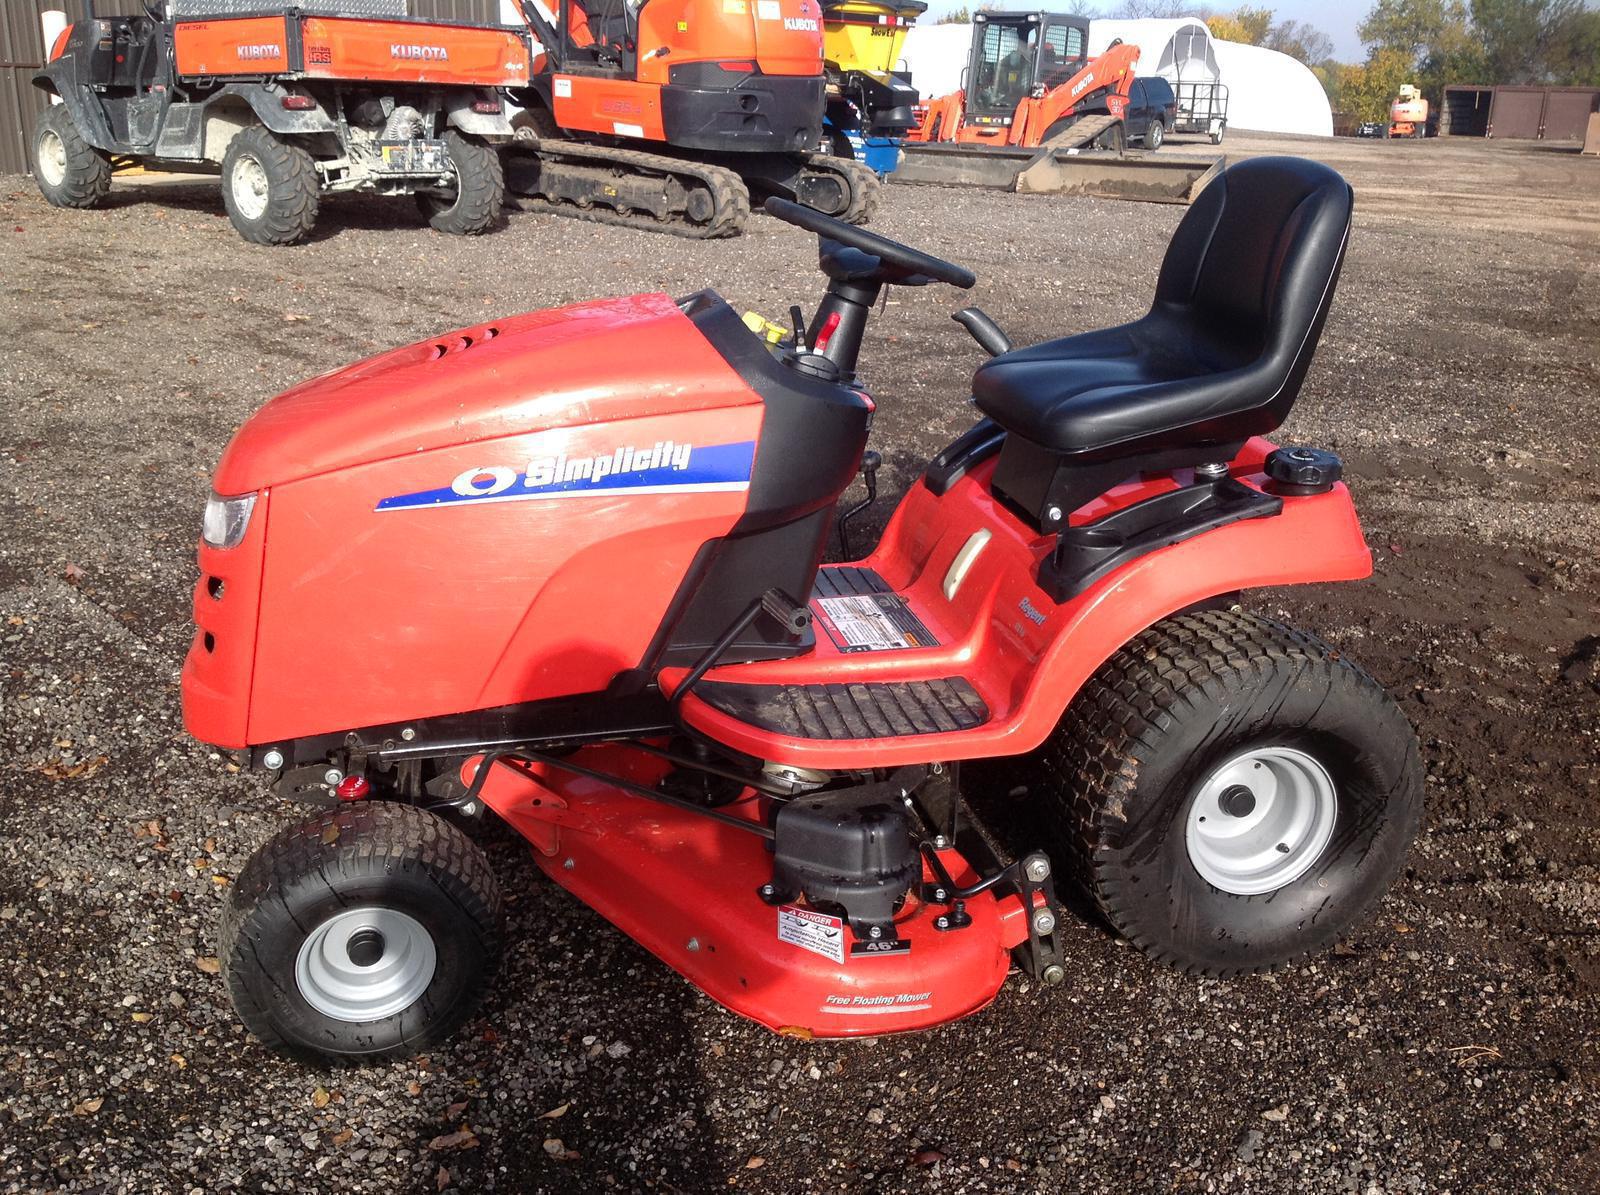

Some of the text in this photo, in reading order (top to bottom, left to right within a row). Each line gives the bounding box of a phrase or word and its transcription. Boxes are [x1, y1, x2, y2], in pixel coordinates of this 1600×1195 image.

[783, 16, 819, 31] KUBOTA
[237, 44, 281, 59] KUBOTA
[390, 44, 449, 61] KUBOTA
[1071, 72, 1095, 97] KUBOTA
[524, 441, 692, 488] Simplicity
[1018, 597, 1047, 626] Regent
[798, 911, 833, 925] DANGER
[783, 925, 817, 941] Amputation
[818, 937, 840, 949] Hazard
[825, 991, 933, 1006] Free Floating Mower
